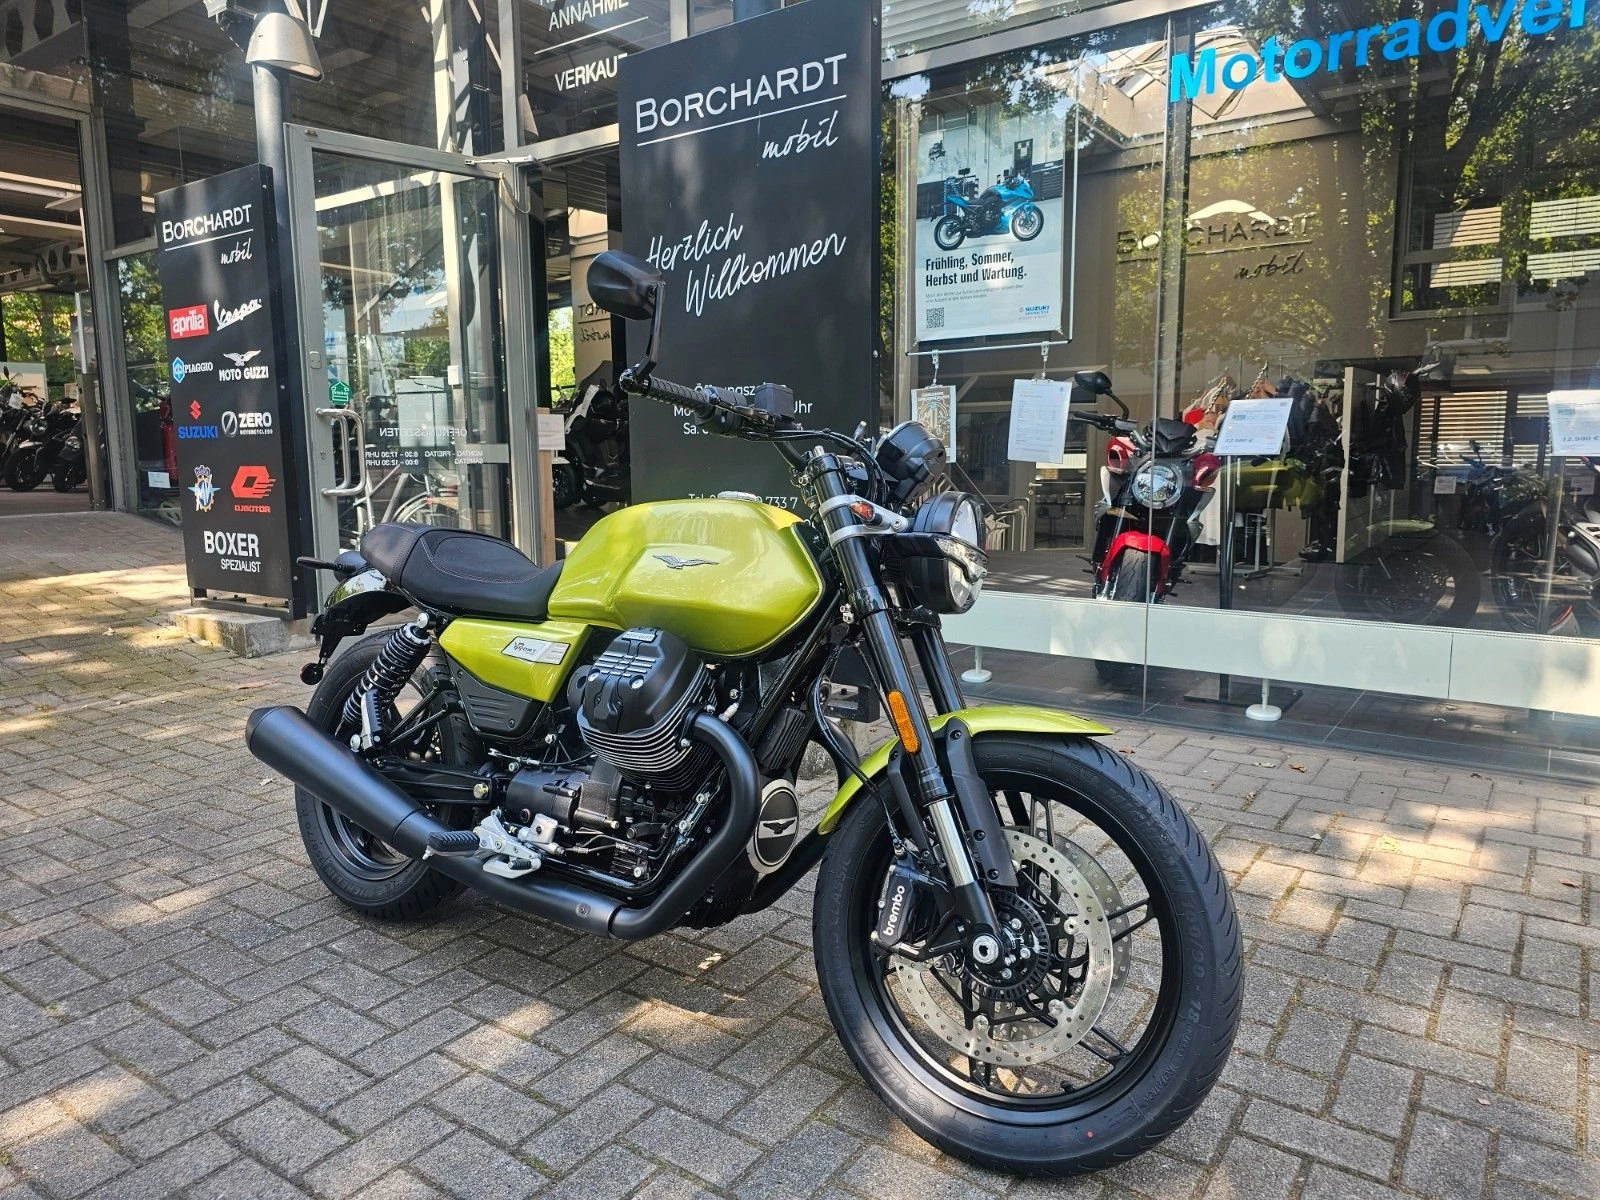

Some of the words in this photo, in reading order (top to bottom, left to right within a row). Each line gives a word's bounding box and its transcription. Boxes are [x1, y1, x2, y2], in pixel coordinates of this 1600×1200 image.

[555, 53, 627, 91] VERKAU
[636, 53, 847, 134] BORCHARDT
[762, 110, 839, 159] mobil
[162, 204, 252, 243] BORCHARDT
[1117, 211, 1317, 254] BOCHARDT
[221, 238, 253, 265] mobil
[646, 212, 743, 271] Herzlich
[685, 233, 847, 317] Willkommen
[925, 255, 968, 272] Frühling,
[971, 251, 1014, 267] Sommer,
[925, 271, 957, 287] Herbst
[960, 269, 979, 284] und
[982, 264, 1027, 282] Wartung.
[172, 309, 205, 337] aprilia
[184, 361, 214, 374] PIAGGIO
[218, 367, 242, 382] MOTO
[244, 365, 269, 380] GUZZI
[178, 425, 219, 439] SUZUKI
[238, 411, 272, 428] ZERO
[203, 530, 260, 558] BOXER
[220, 558, 262, 573] SPEZIALIST
[882, 885, 906, 937] brembo
